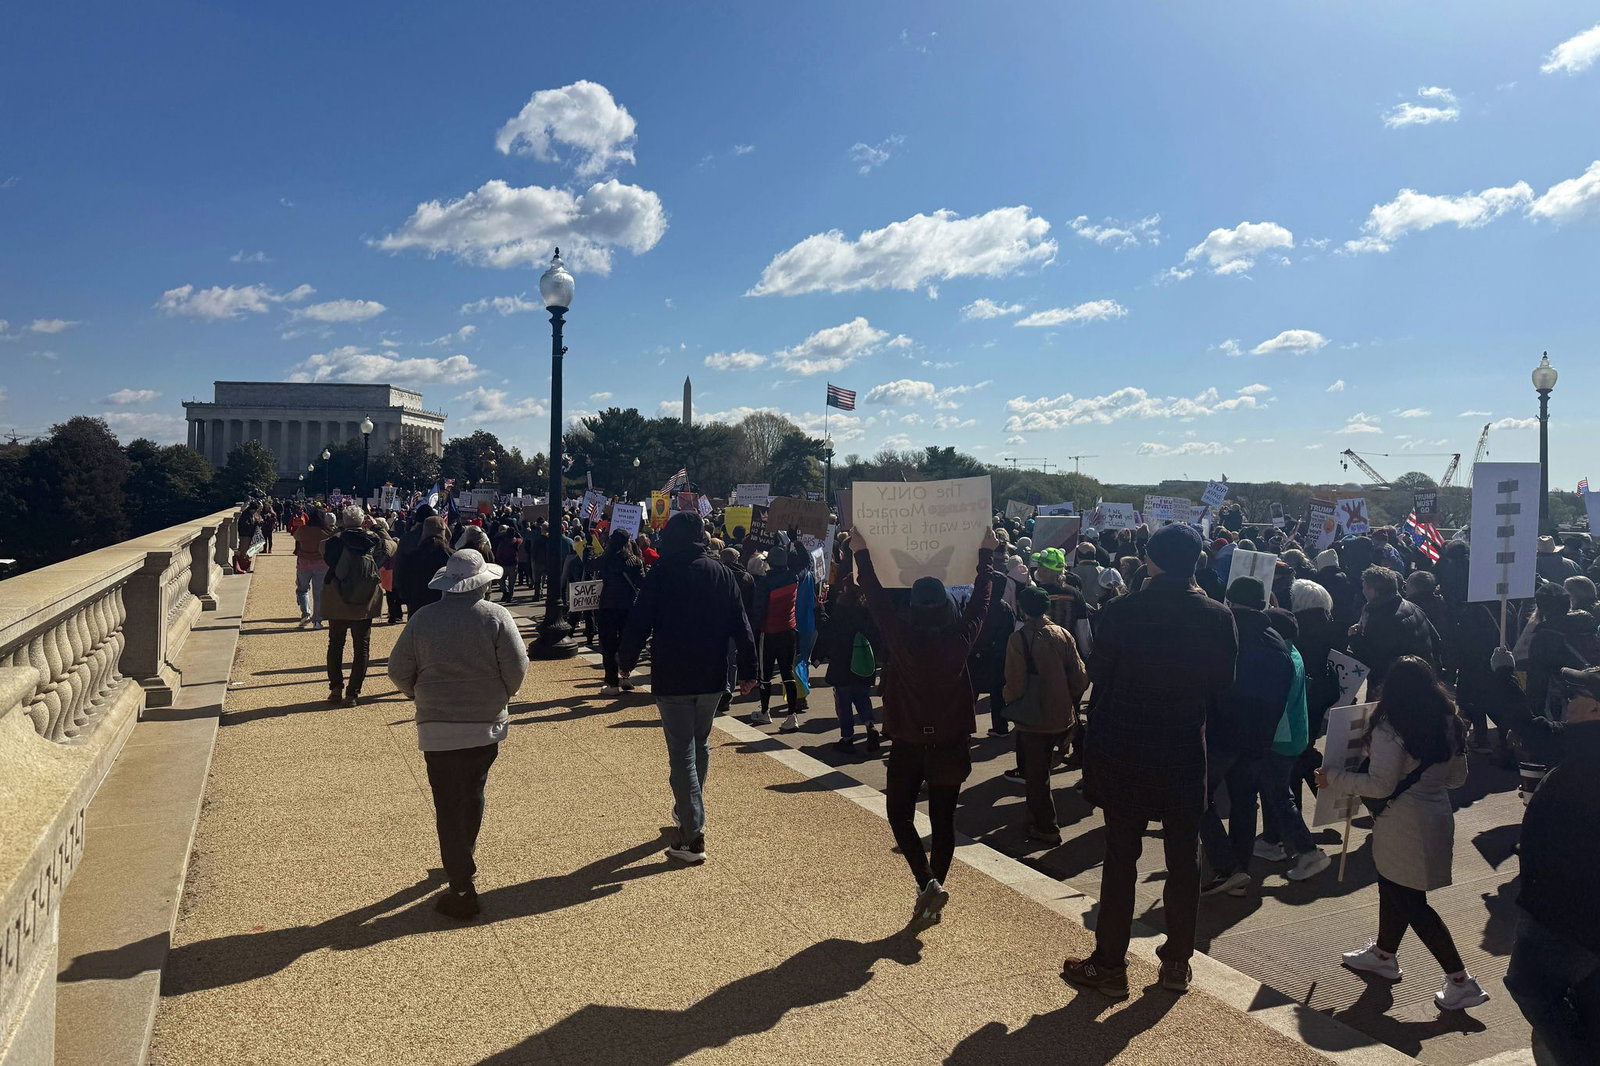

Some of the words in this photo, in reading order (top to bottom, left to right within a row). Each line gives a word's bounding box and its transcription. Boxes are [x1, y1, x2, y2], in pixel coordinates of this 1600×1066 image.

[1208, 483, 1227, 493] STOP
[1310, 503, 1334, 514] TRUMP
[760, 530, 775, 538] ICE
[759, 537, 775, 545] WAR
[574, 584, 597, 596] SAVE
[573, 595, 602, 607] DEMOCRA
